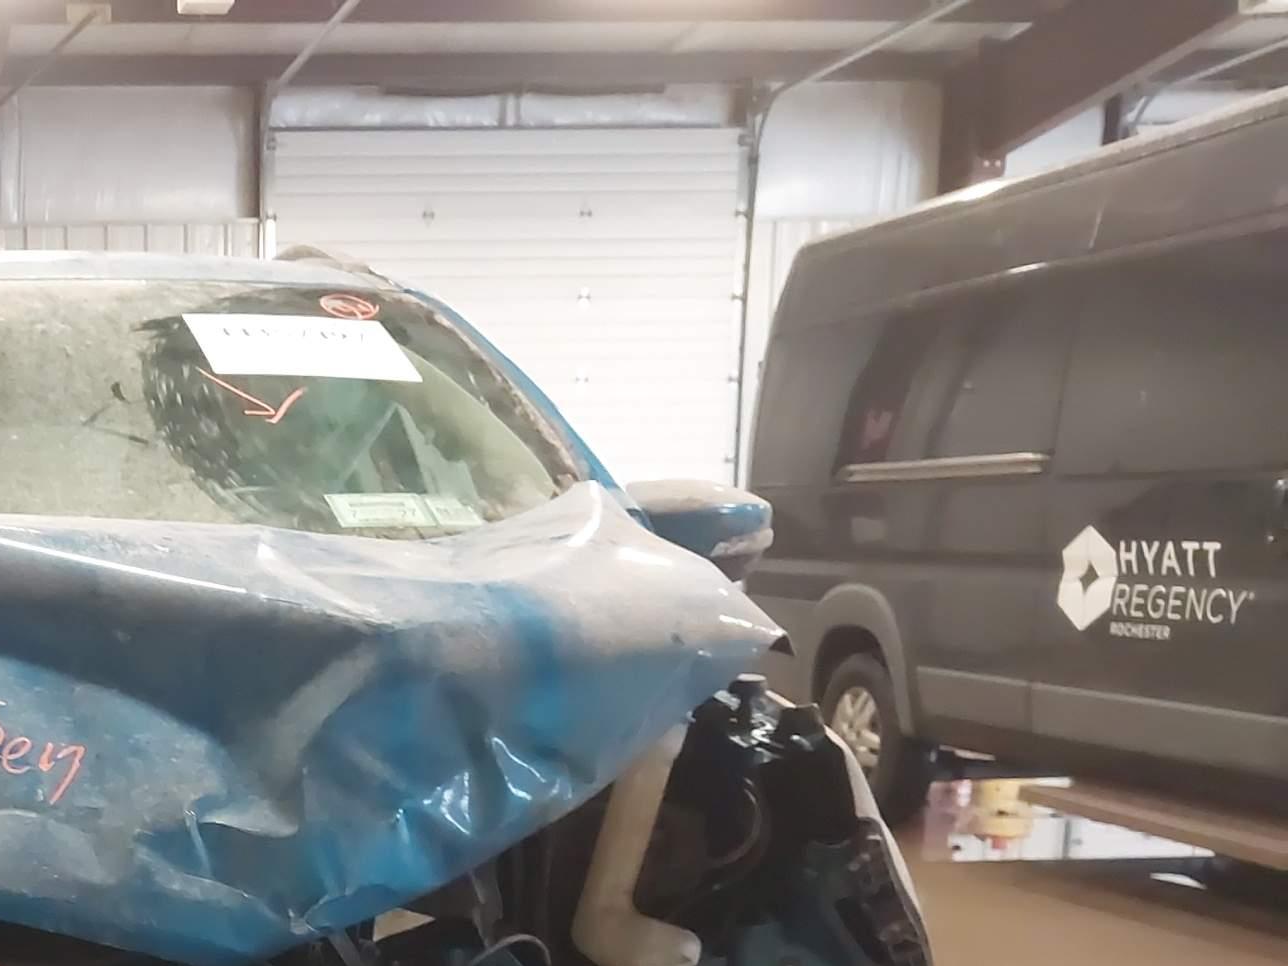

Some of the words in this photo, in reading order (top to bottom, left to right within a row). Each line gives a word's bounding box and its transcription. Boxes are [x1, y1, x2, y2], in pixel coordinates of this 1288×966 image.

[1118, 539, 1222, 578] HYATT
[1113, 583, 1249, 625] REGENCY
[1109, 621, 1171, 640] ROCHESTER
